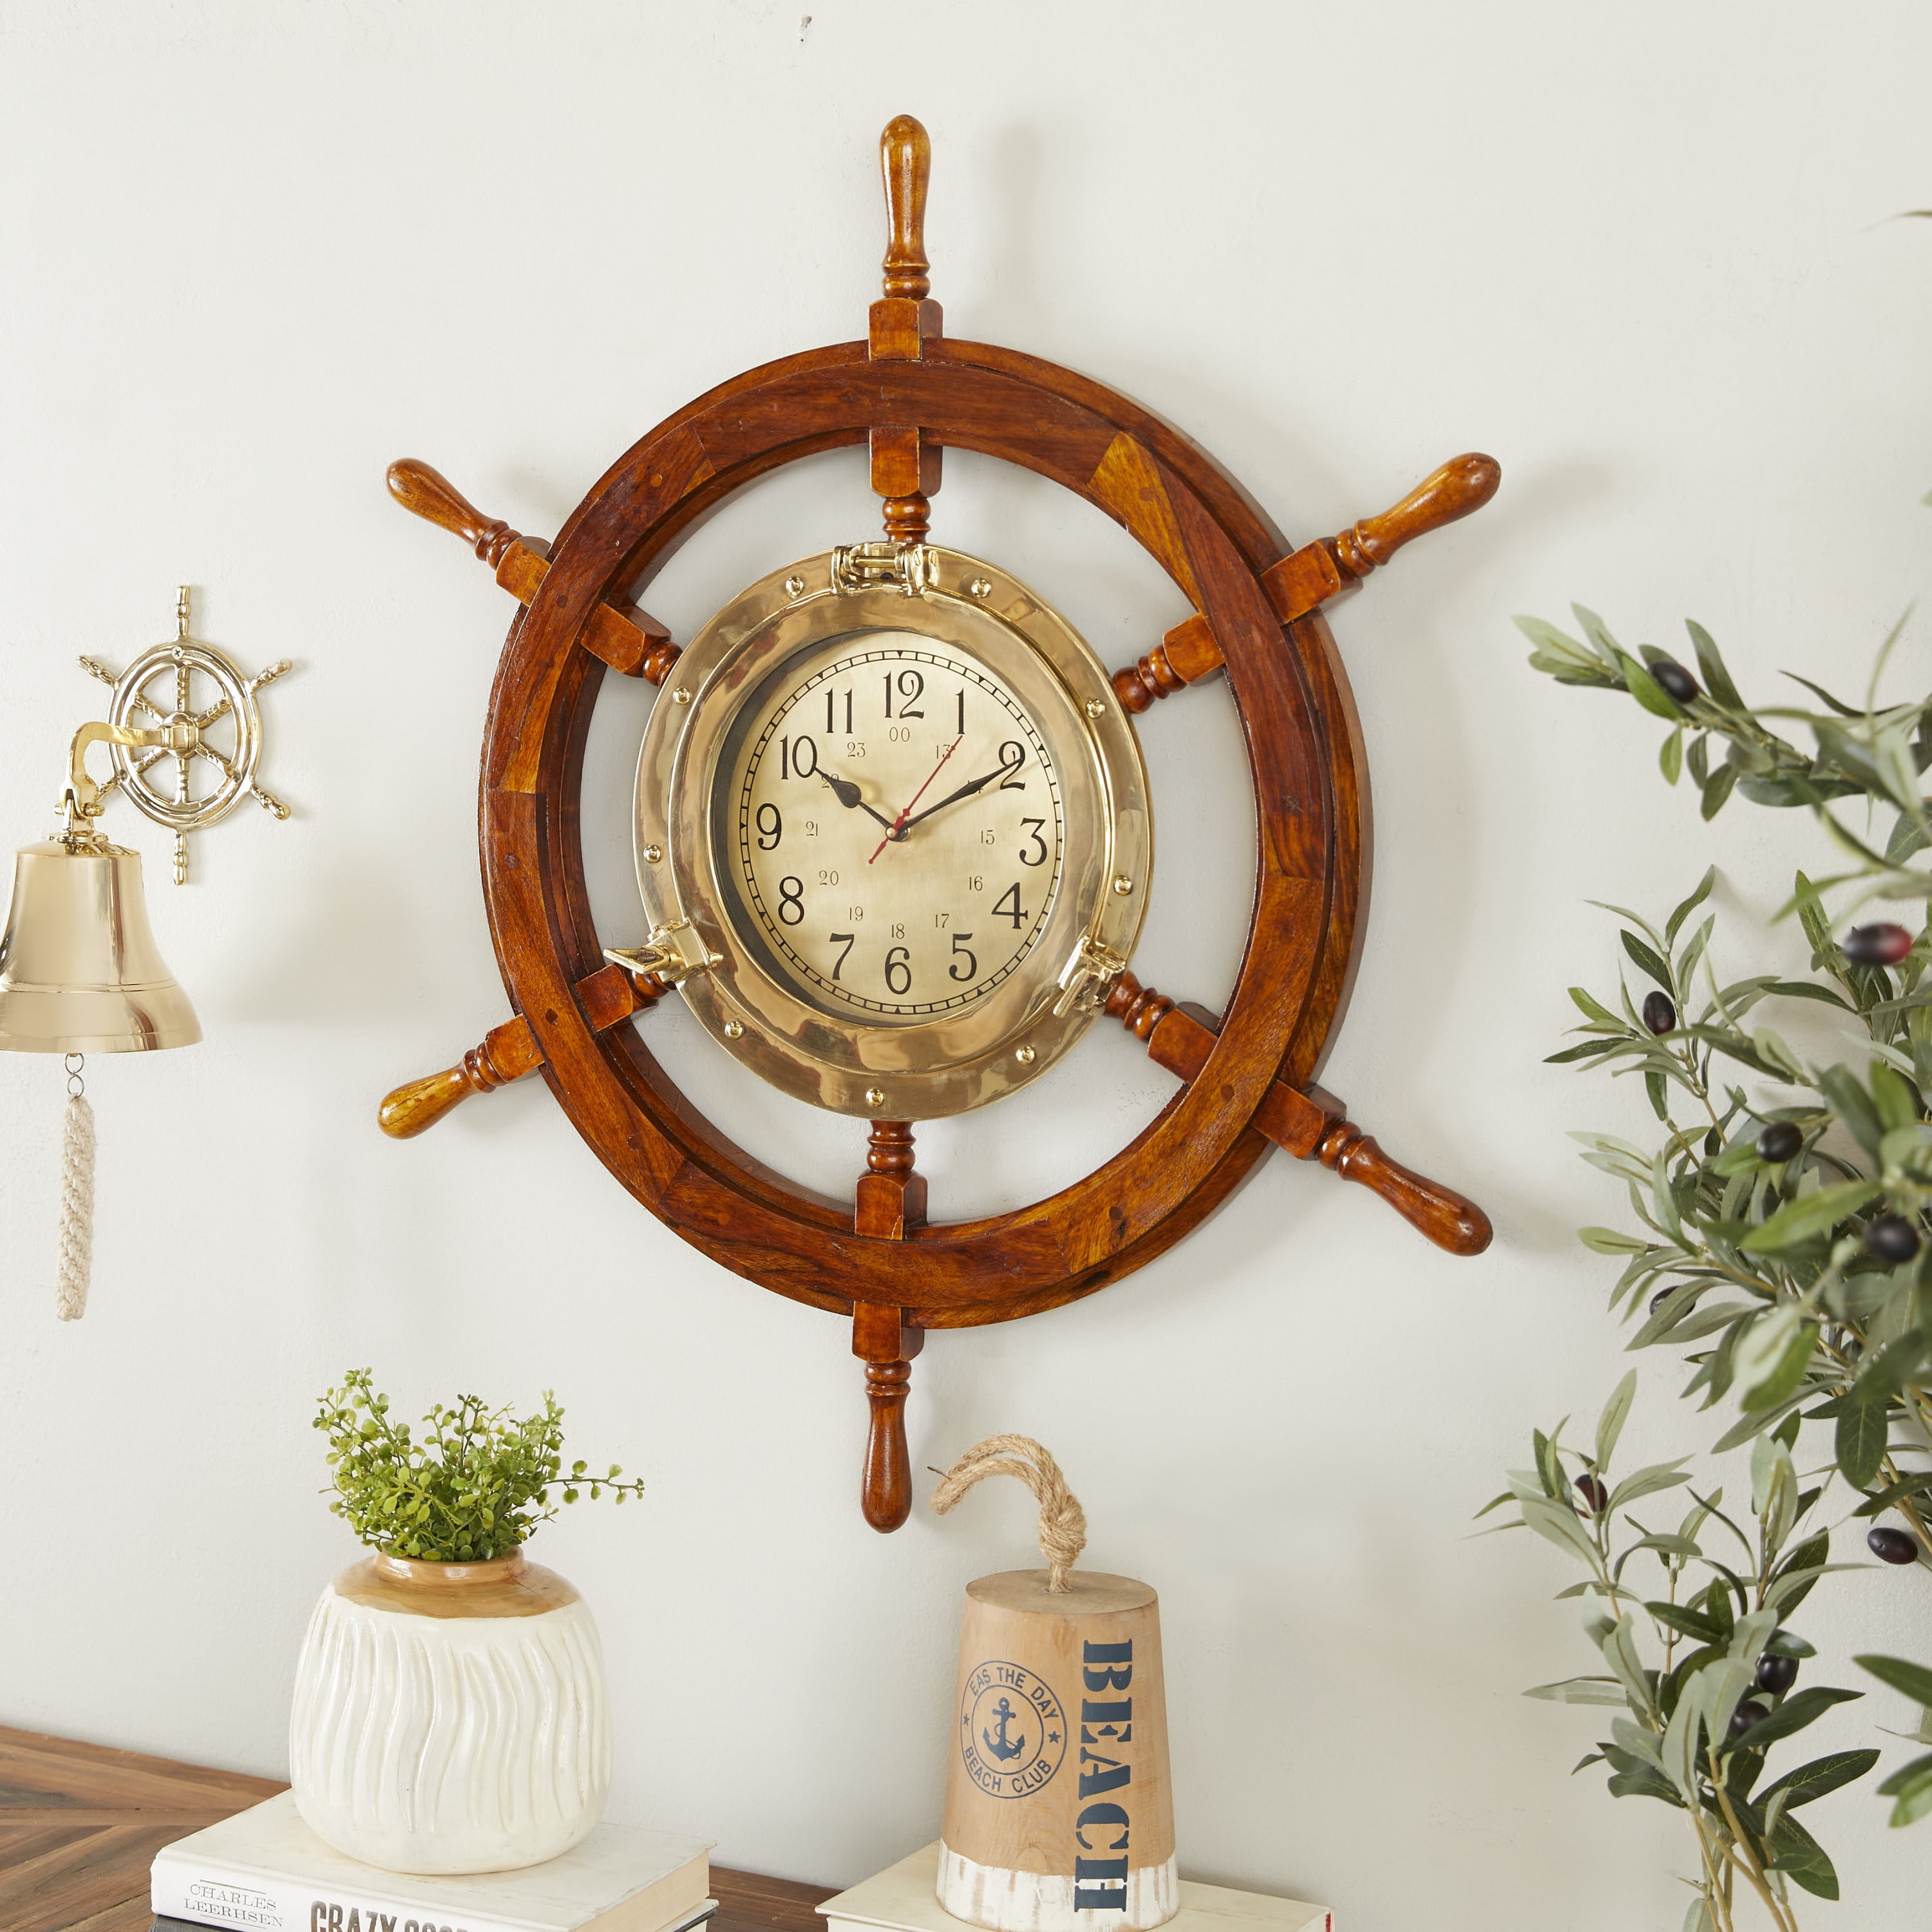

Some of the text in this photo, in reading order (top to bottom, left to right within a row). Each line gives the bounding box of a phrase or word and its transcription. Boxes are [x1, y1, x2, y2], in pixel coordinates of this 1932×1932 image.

[824, 687, 853, 734] 11
[882, 670, 925, 719] 12
[954, 688, 965, 735] 1
[779, 734, 818, 780] 10
[847, 742, 866, 758] 23
[889, 726, 911, 743] 00
[936, 744, 952, 759] 13
[998, 741, 1026, 790] 2
[756, 803, 782, 851] 9
[805, 820, 819, 837] 21
[980, 830, 995, 846] 15
[1019, 817, 1048, 866] 3
[778, 876, 805, 926] 8
[819, 869, 839, 886] 20
[968, 875, 983, 891] 16
[848, 906, 864, 922] 19
[934, 913, 950, 929] 17
[991, 882, 1028, 929] 4
[891, 923, 905, 940] 18
[829, 932, 855, 981] 7
[884, 947, 912, 995] 6
[949, 933, 978, 982] 5
[996, 1667, 1027, 1689] THE
[1030, 1686, 1059, 1719] DAY
[965, 1746, 1052, 1793] BEACH CLUB
[1074, 1638, 1133, 1912] BEACH
[184, 1898, 284, 1927] LEERHSEN
[190, 1884, 277, 1911] CHARLES
